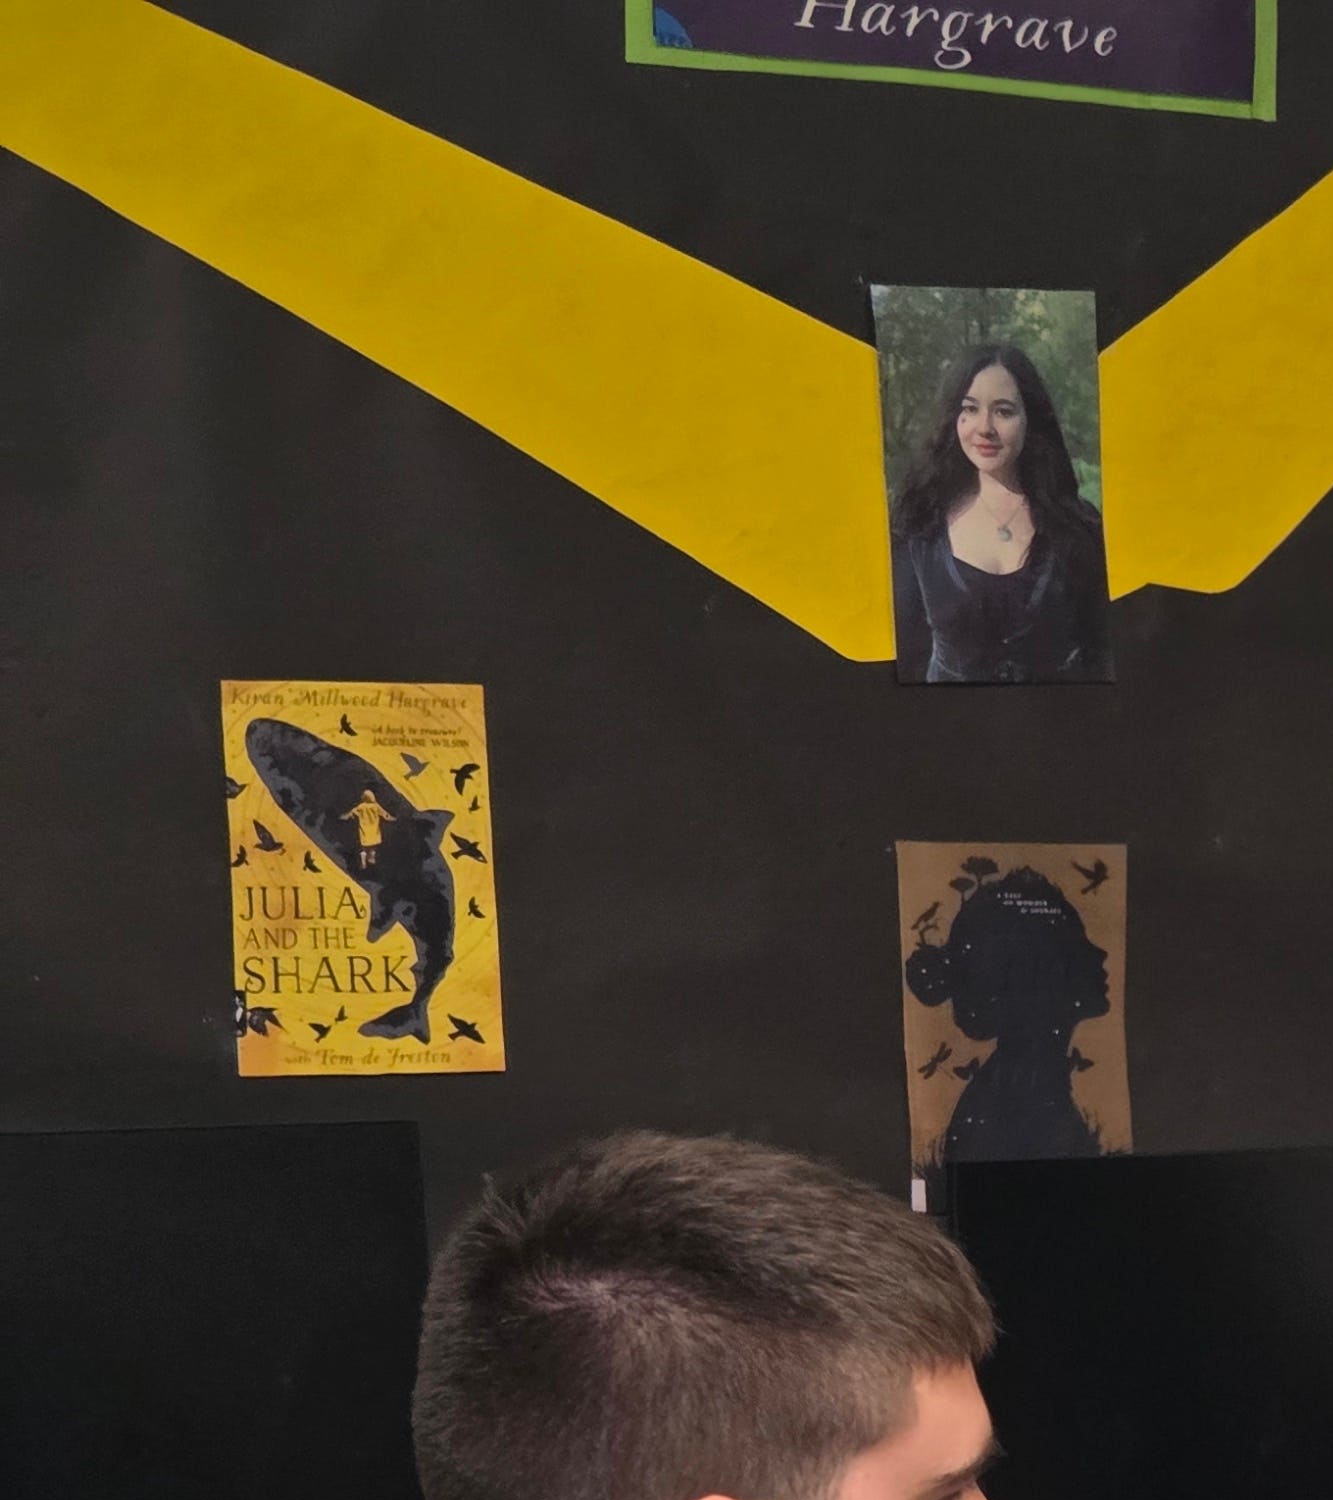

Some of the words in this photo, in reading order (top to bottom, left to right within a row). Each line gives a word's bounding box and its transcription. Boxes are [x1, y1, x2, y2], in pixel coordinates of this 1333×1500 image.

[793, 0, 1117, 69] Hargrave
[232, 685, 284, 706] Kiran
[294, 687, 381, 708] Millwood
[239, 885, 364, 922] JULIA
[243, 927, 298, 950] AND
[308, 927, 357, 950] THE
[242, 955, 411, 995] SHARK
[317, 1048, 354, 1067] Tom
[361, 1047, 381, 1066] de
[388, 1049, 452, 1068] Freston
